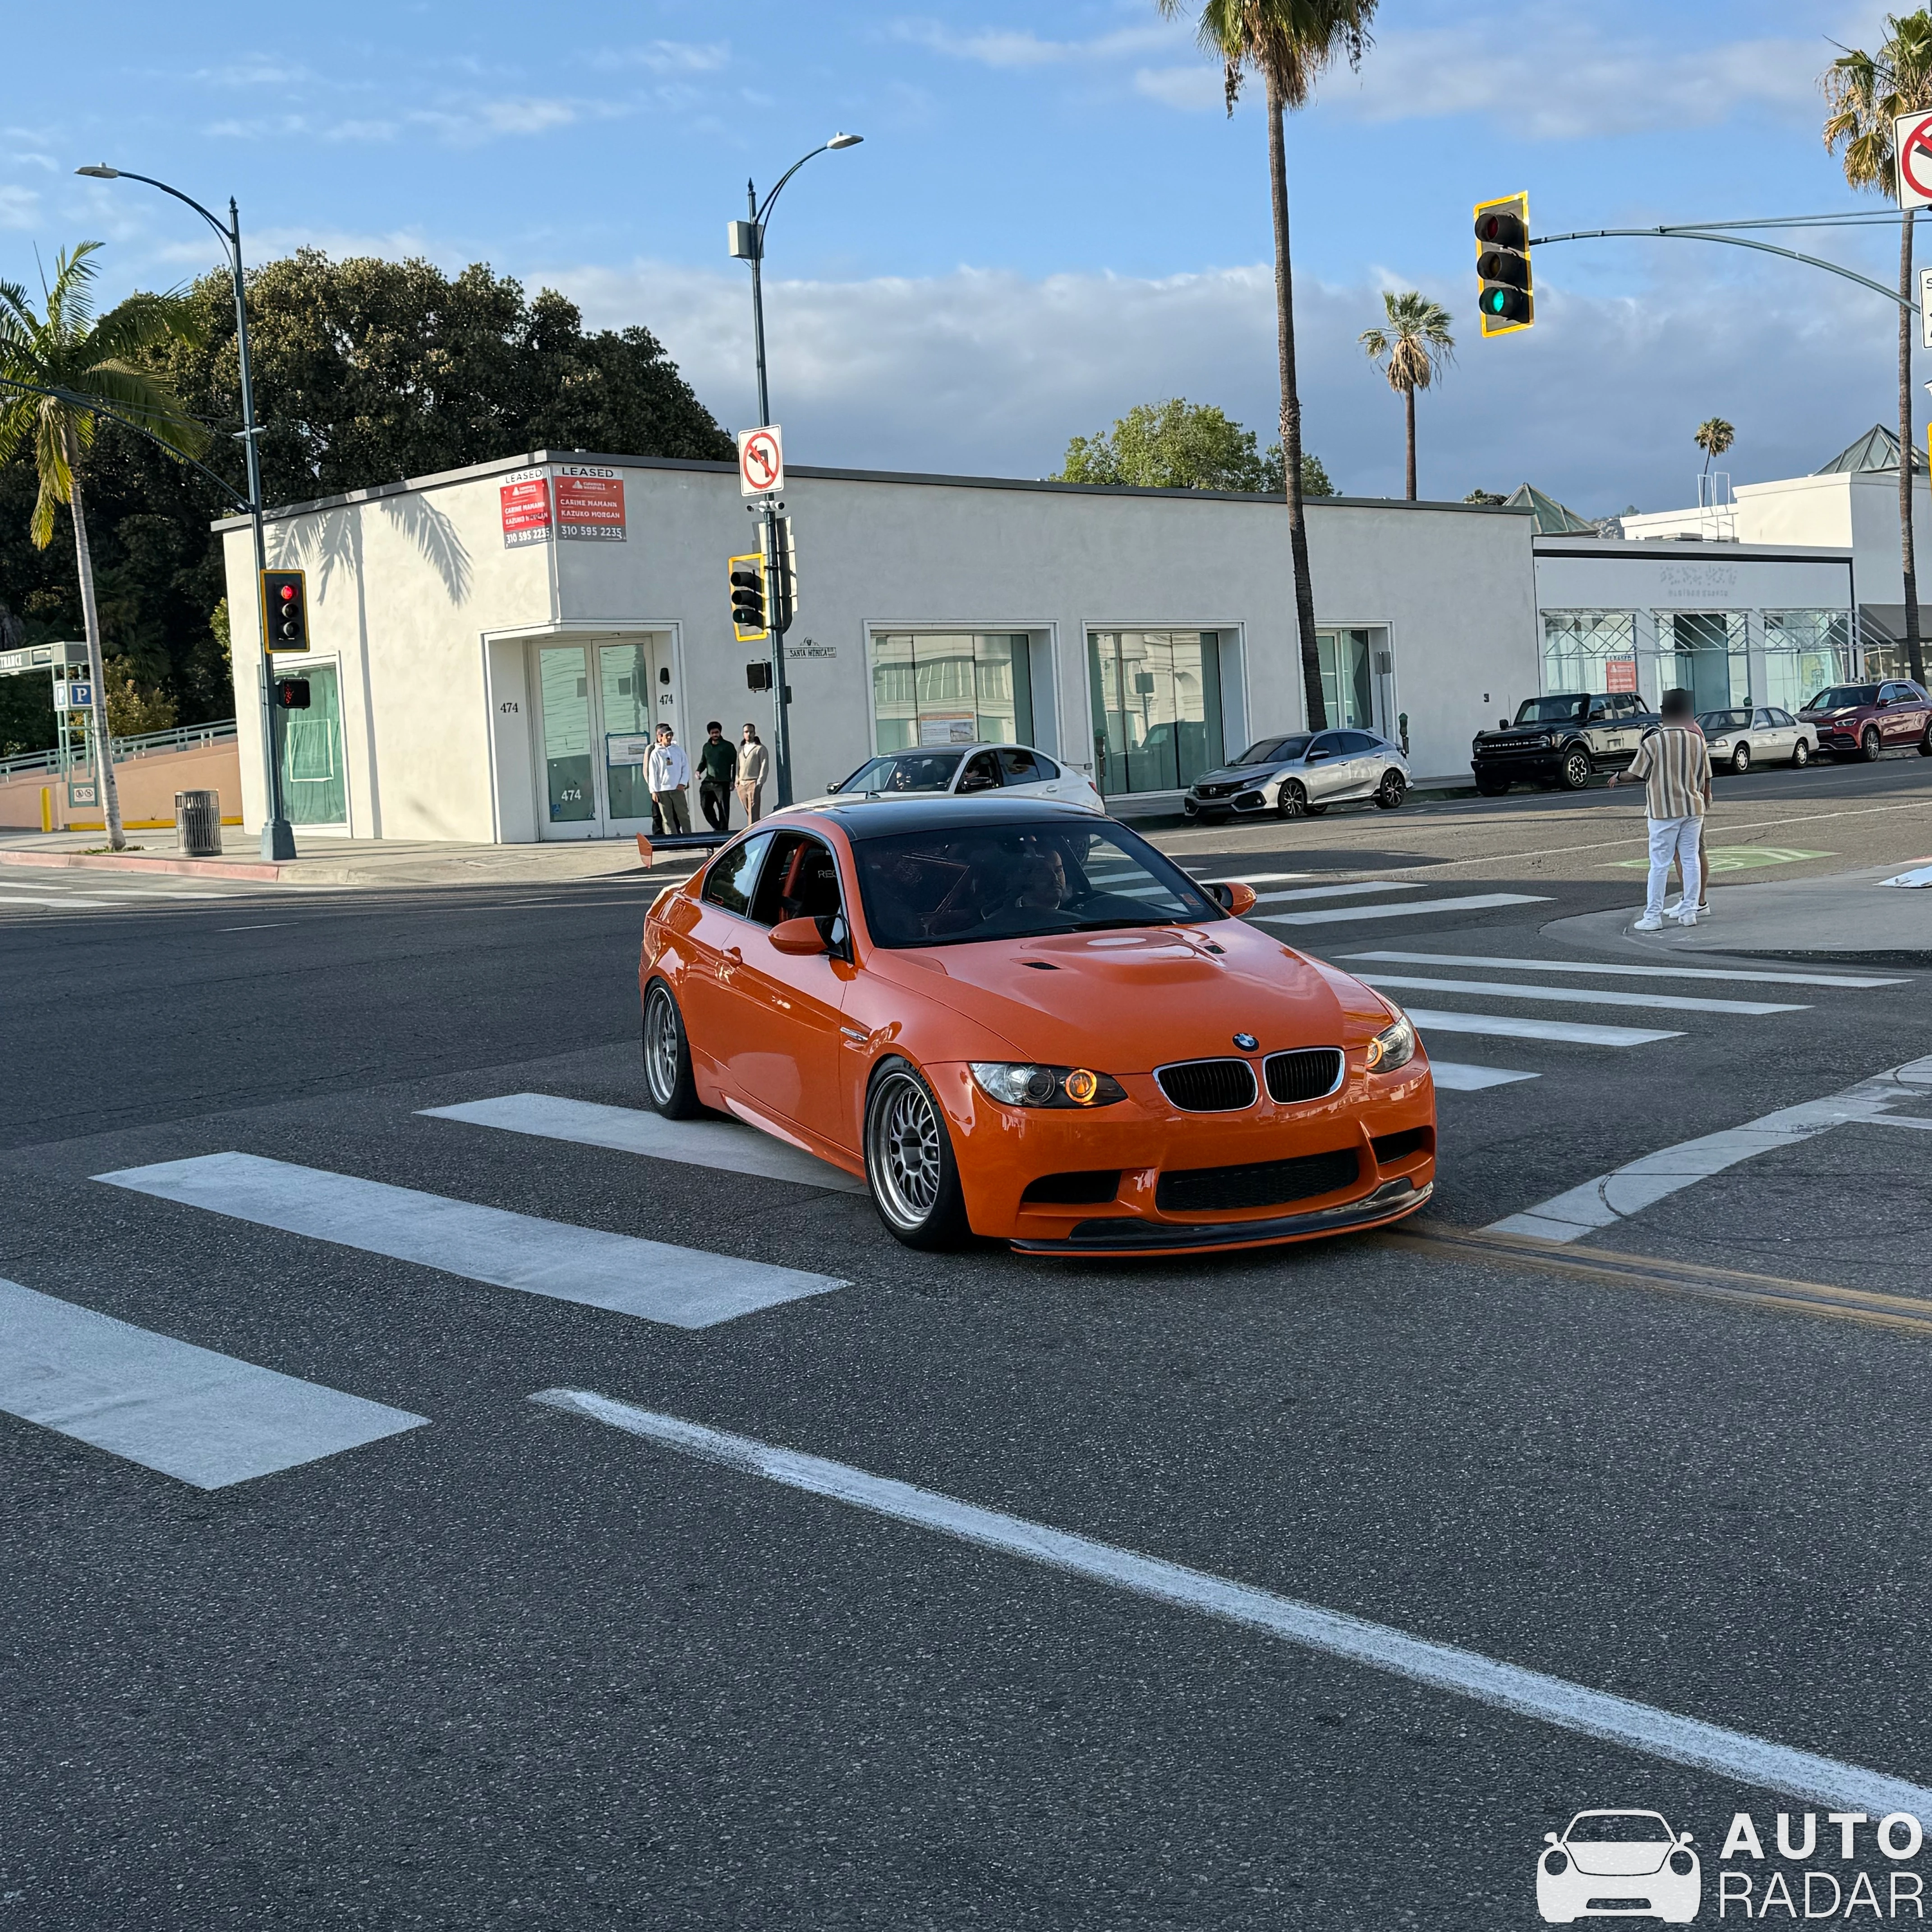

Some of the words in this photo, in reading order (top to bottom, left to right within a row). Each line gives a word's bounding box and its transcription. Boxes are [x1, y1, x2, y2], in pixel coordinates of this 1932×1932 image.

[506, 469, 543, 483] LEASED
[562, 467, 614, 478] LEASED
[506, 533, 517, 543] 310
[519, 530, 531, 541] 595
[561, 525, 577, 535] 310
[580, 526, 597, 535] 595
[600, 527, 622, 537] 2235
[0, 654, 22, 668] TRANCE
[76, 688, 87, 702] P
[659, 694, 673, 705] 474
[500, 703, 518, 713] 474
[561, 789, 581, 801] 474
